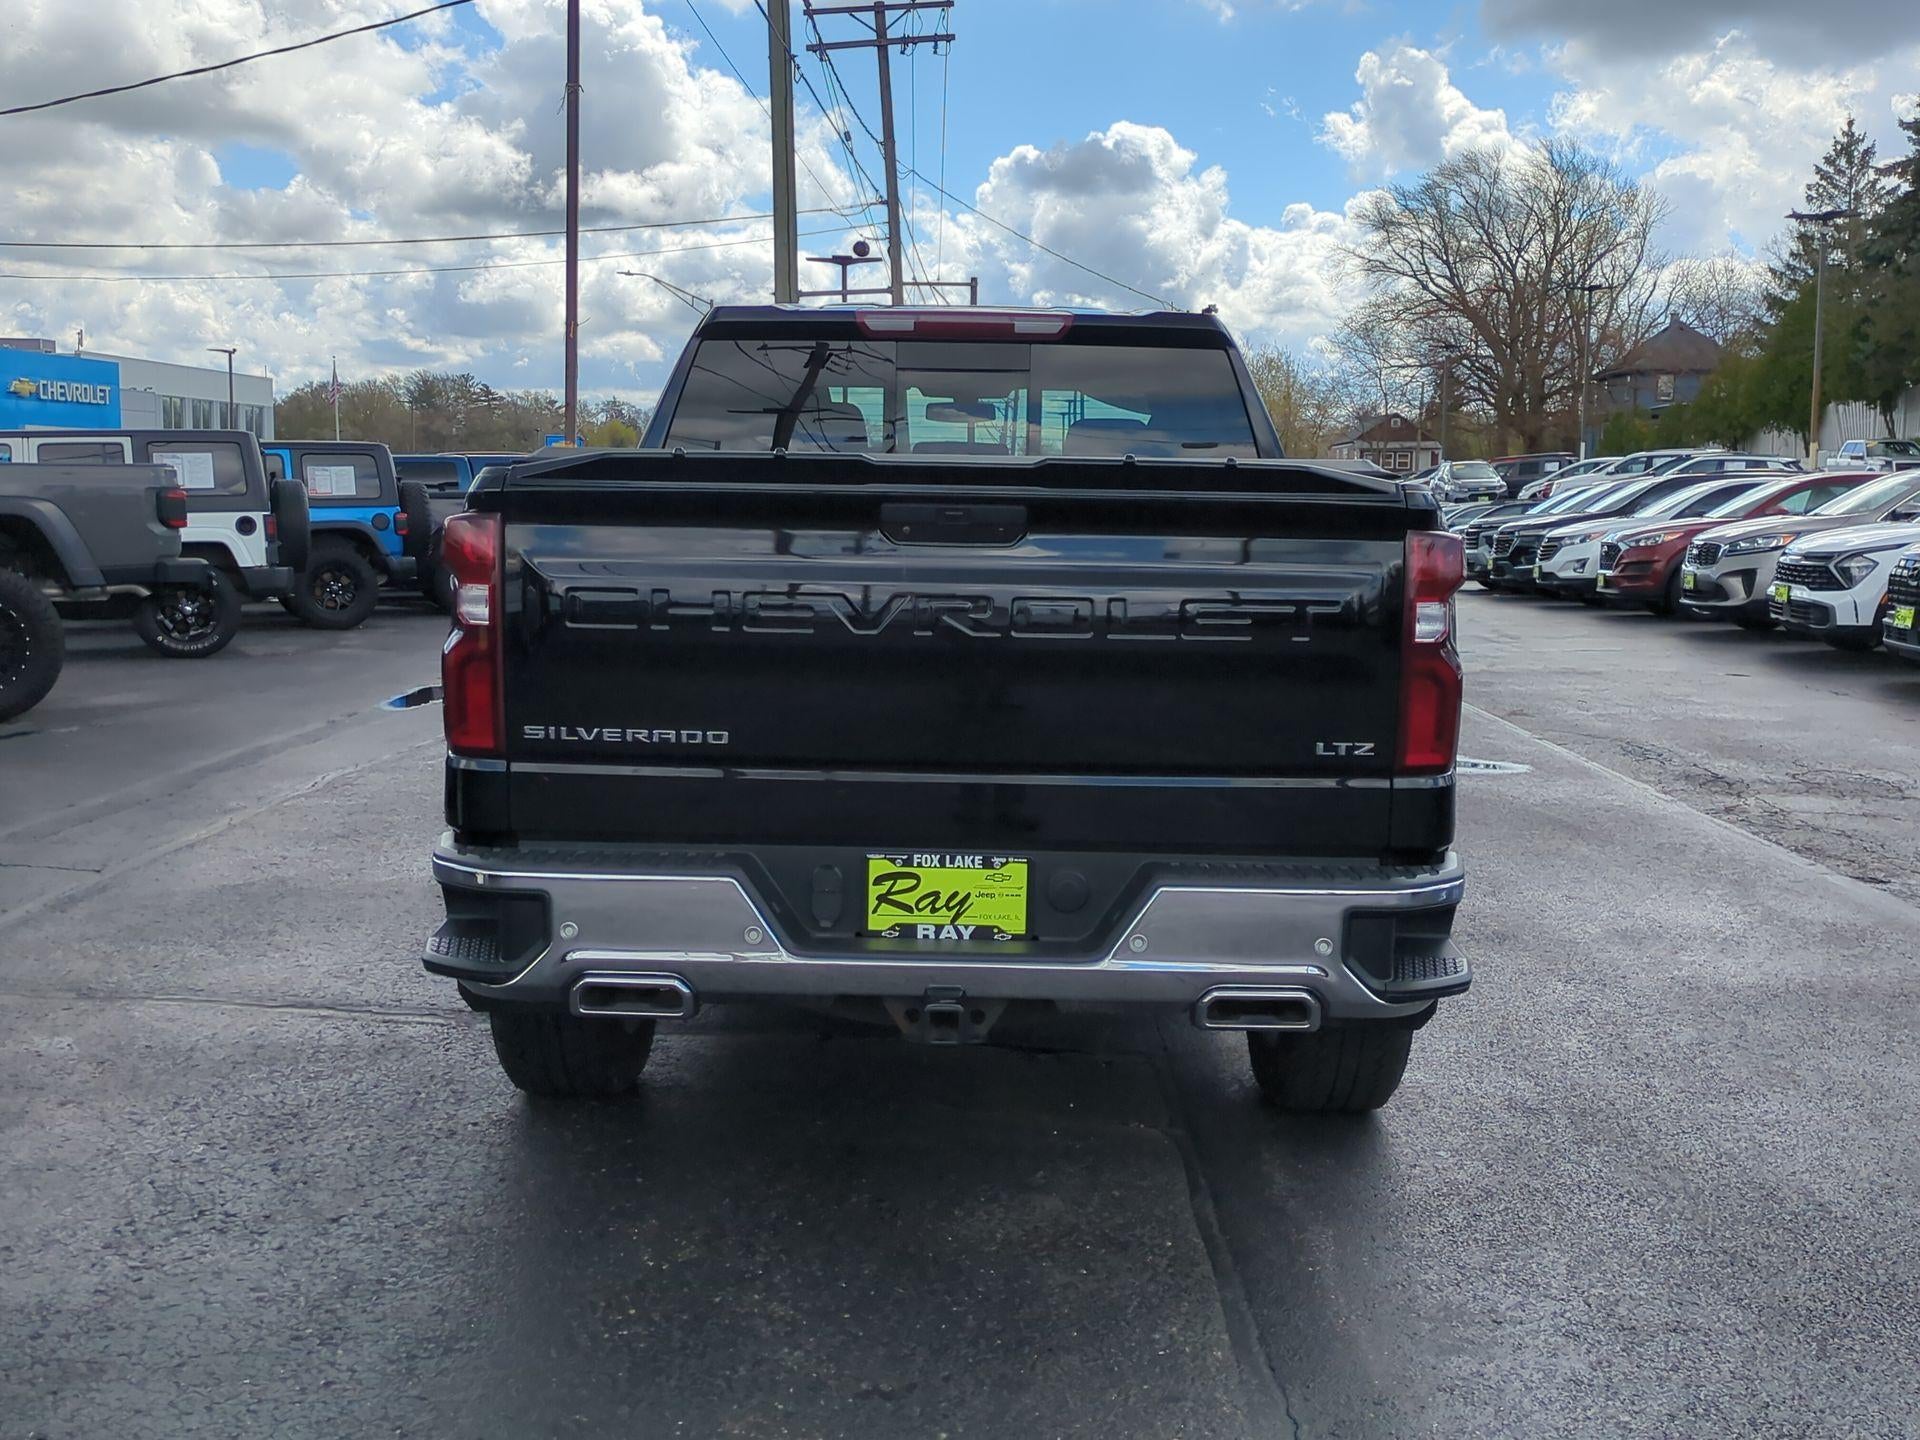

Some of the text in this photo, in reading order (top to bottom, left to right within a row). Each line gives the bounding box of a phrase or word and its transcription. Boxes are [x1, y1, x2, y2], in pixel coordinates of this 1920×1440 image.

[40, 379, 111, 405] CHEVROLET
[564, 585, 1344, 643] CHEVROLET
[523, 725, 729, 744] SILVERADO
[1316, 742, 1375, 756] LTZ
[913, 853, 940, 868] FOX
[945, 855, 983, 869] LAKE
[871, 871, 974, 924] Ray
[975, 891, 996, 899] Jeep
[916, 924, 976, 940] RAY
